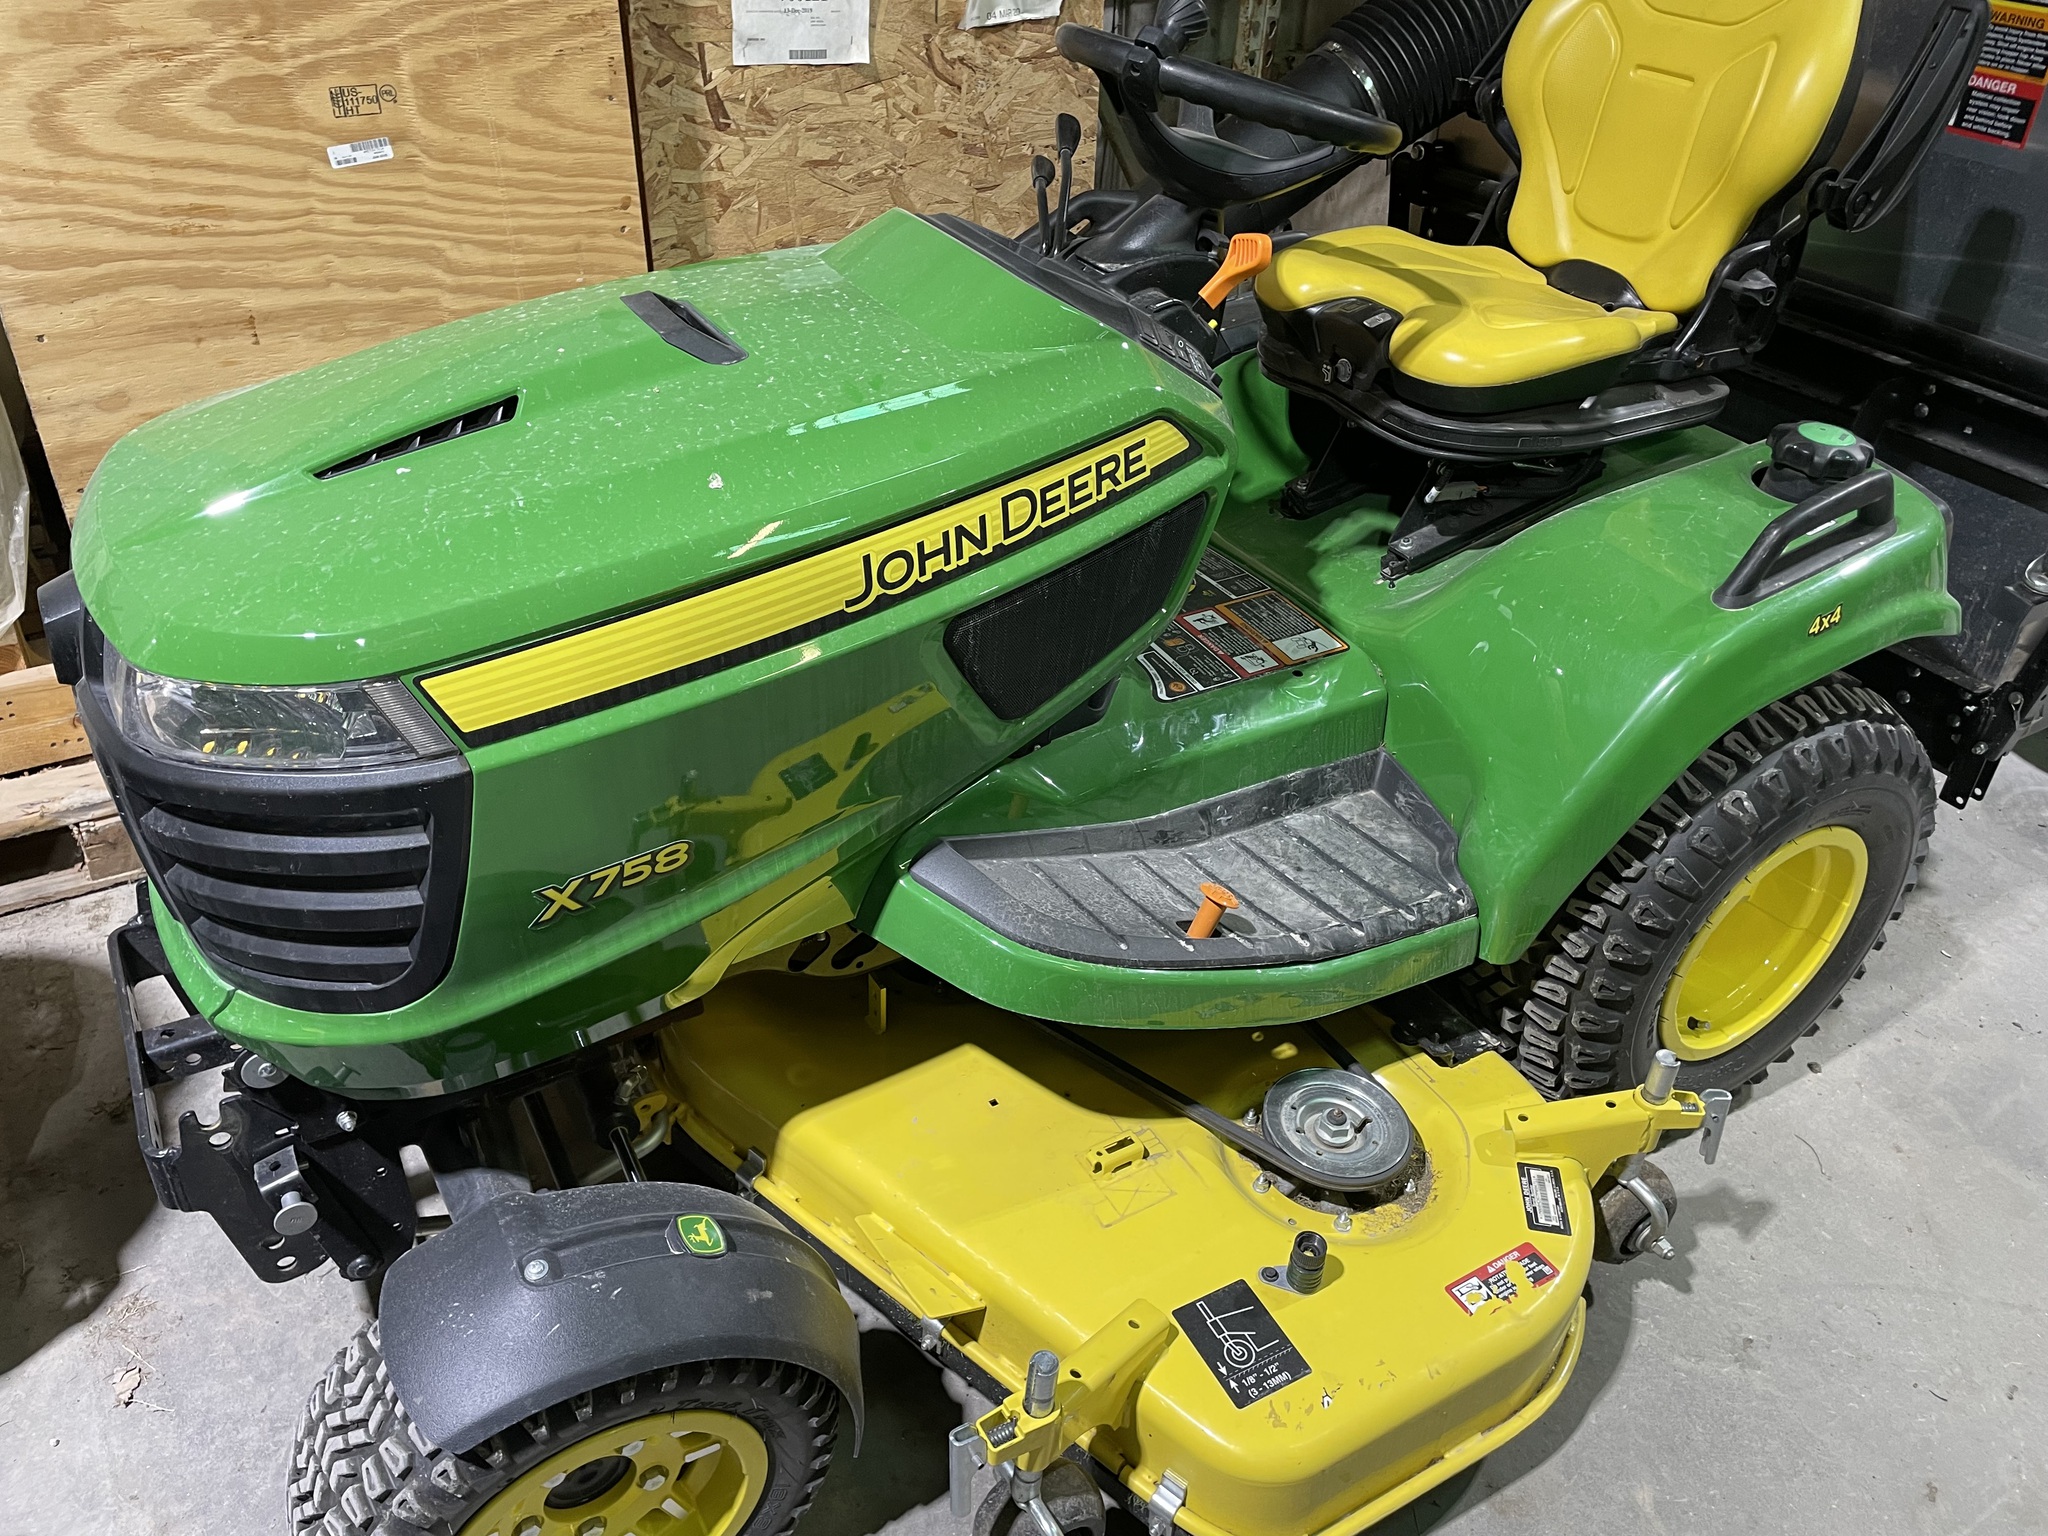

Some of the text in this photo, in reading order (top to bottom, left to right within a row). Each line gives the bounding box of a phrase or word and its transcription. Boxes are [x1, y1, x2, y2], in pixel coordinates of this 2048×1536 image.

[1990, 10, 2046, 30] WARNING
[1968, 74, 2018, 95] DANGER
[344, 95, 378, 106] 111750
[345, 105, 361, 115] HT
[844, 438, 1148, 610] JOHN DEERE
[1808, 605, 1842, 635] 4x4
[537, 842, 689, 923] X758
[1491, 1250, 1521, 1270] DANGER
[1241, 1373, 1258, 1387] 1/8"
[1263, 1362, 1279, 1376] 1/2"
[1248, 1387, 1259, 1399] (3
[1262, 1371, 1292, 1390] 13MM)
